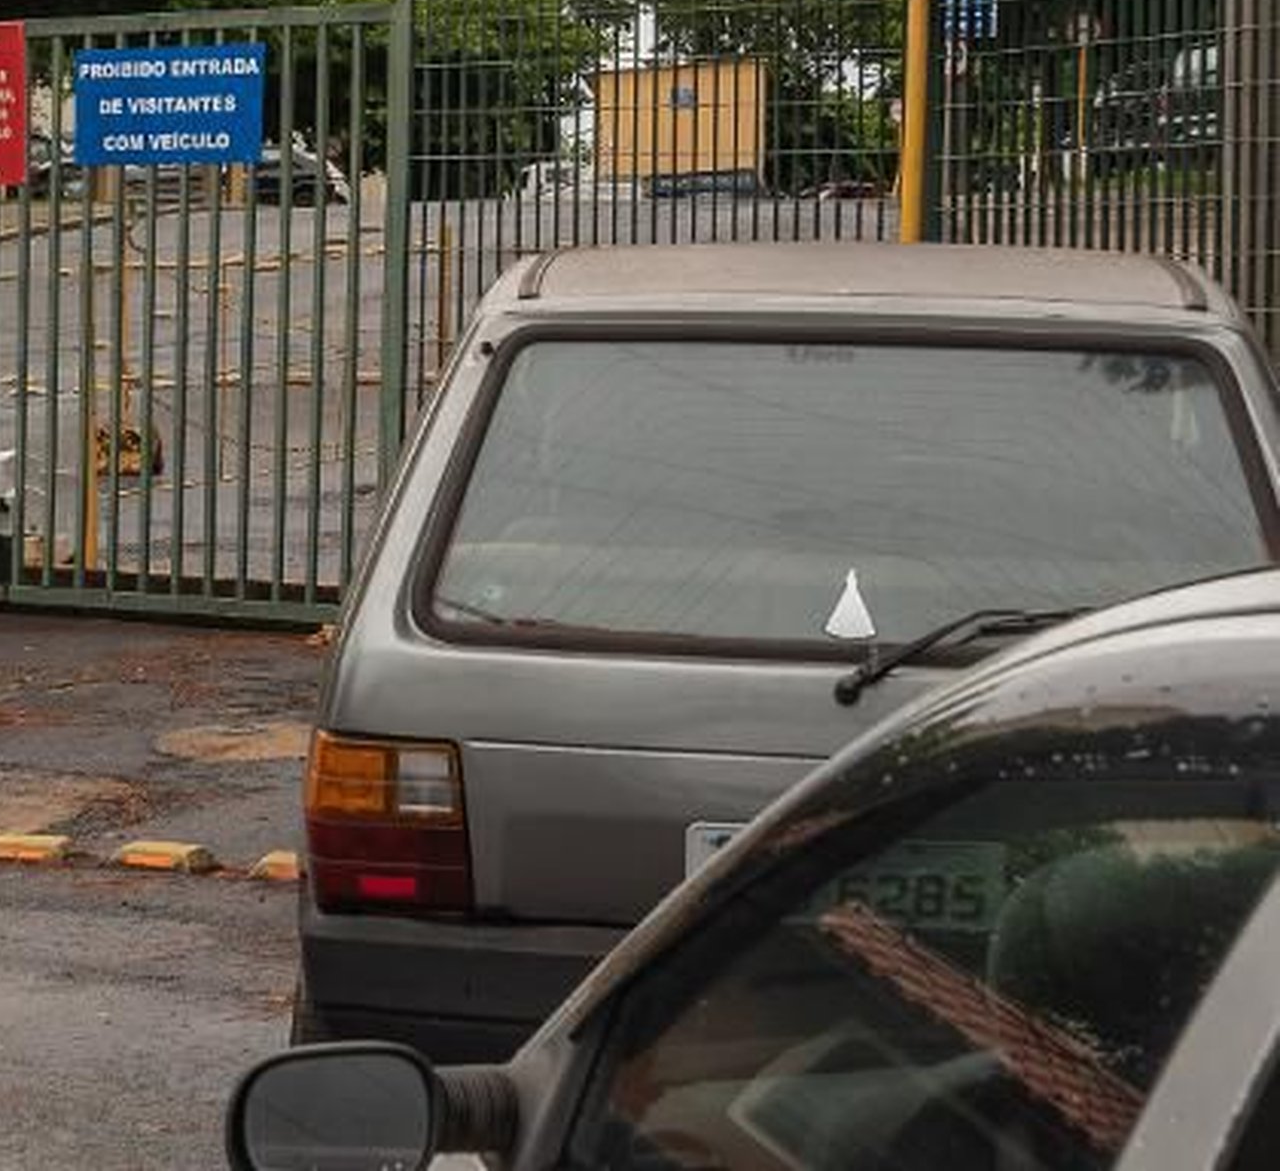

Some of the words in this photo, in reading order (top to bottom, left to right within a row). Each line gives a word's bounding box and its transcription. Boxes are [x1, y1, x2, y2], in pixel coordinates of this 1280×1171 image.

[79, 61, 165, 79] PROIBIDO
[170, 58, 259, 76] ENTRADA
[100, 99, 122, 114] DE
[127, 95, 236, 114] VISITANTES
[103, 135, 144, 151] COM
[148, 131, 230, 150] VEÍCULO
